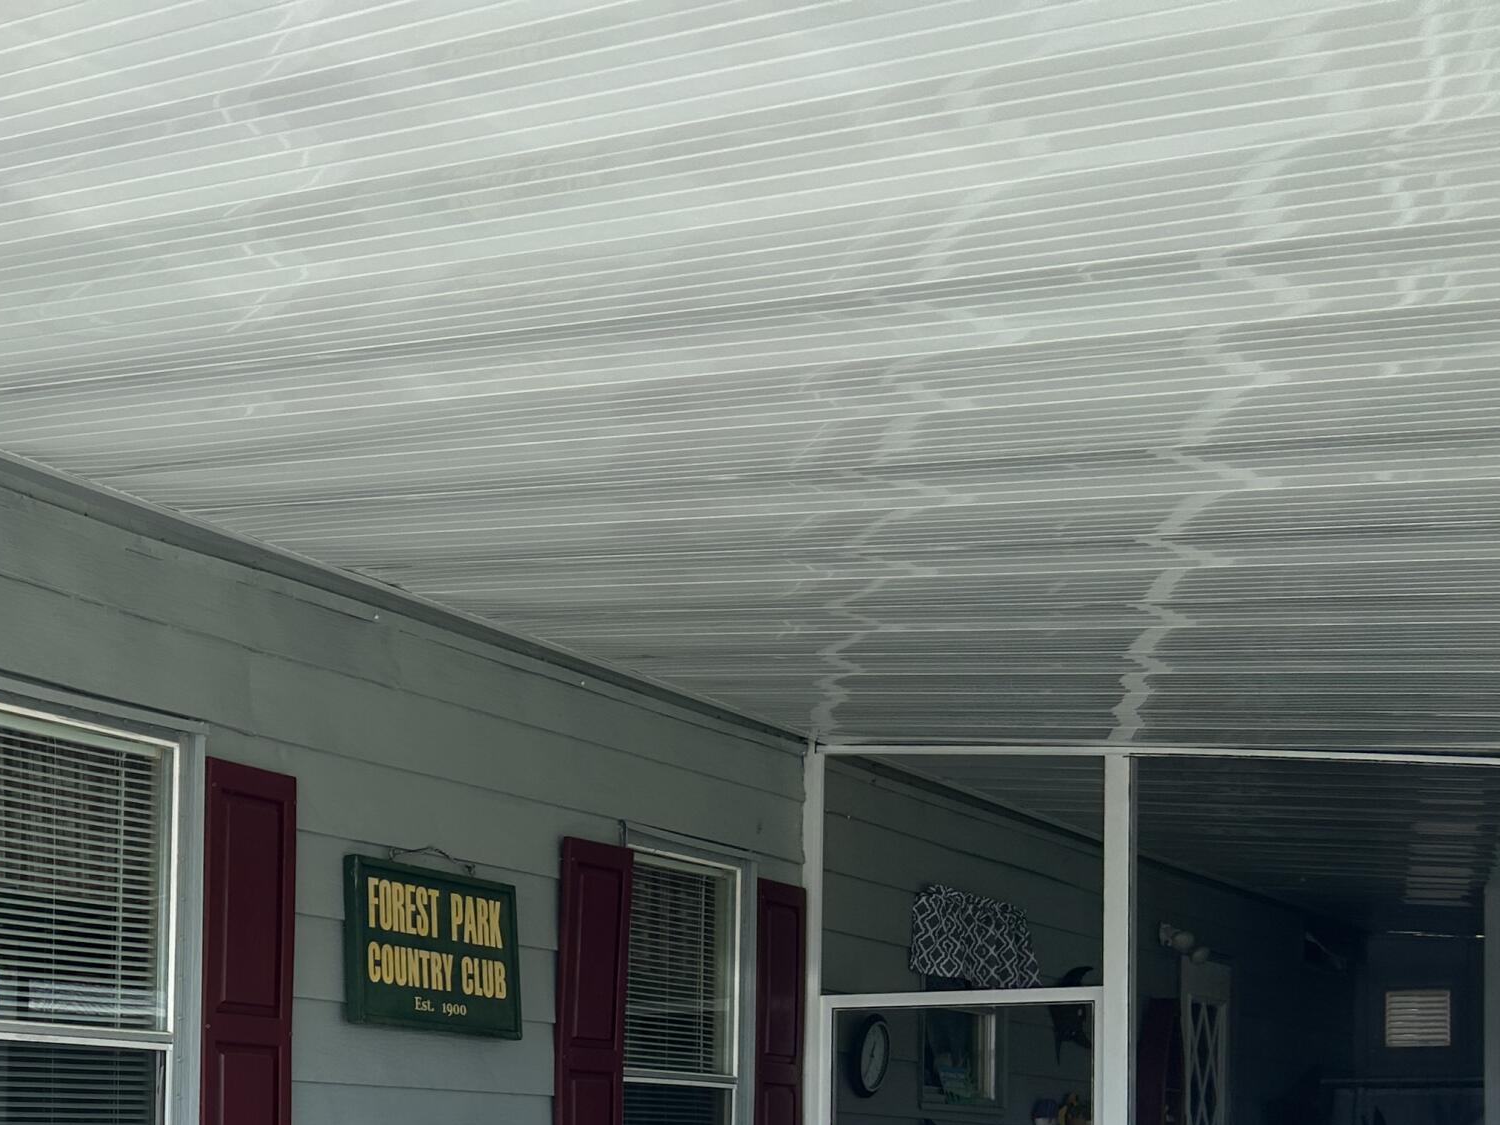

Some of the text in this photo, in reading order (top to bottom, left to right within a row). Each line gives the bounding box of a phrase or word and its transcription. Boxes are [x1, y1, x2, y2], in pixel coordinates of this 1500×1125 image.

[367, 876, 503, 949] FOREST PARK
[367, 941, 507, 1000] COUNTRY CLUB
[414, 996, 467, 1017] Est. 1900
